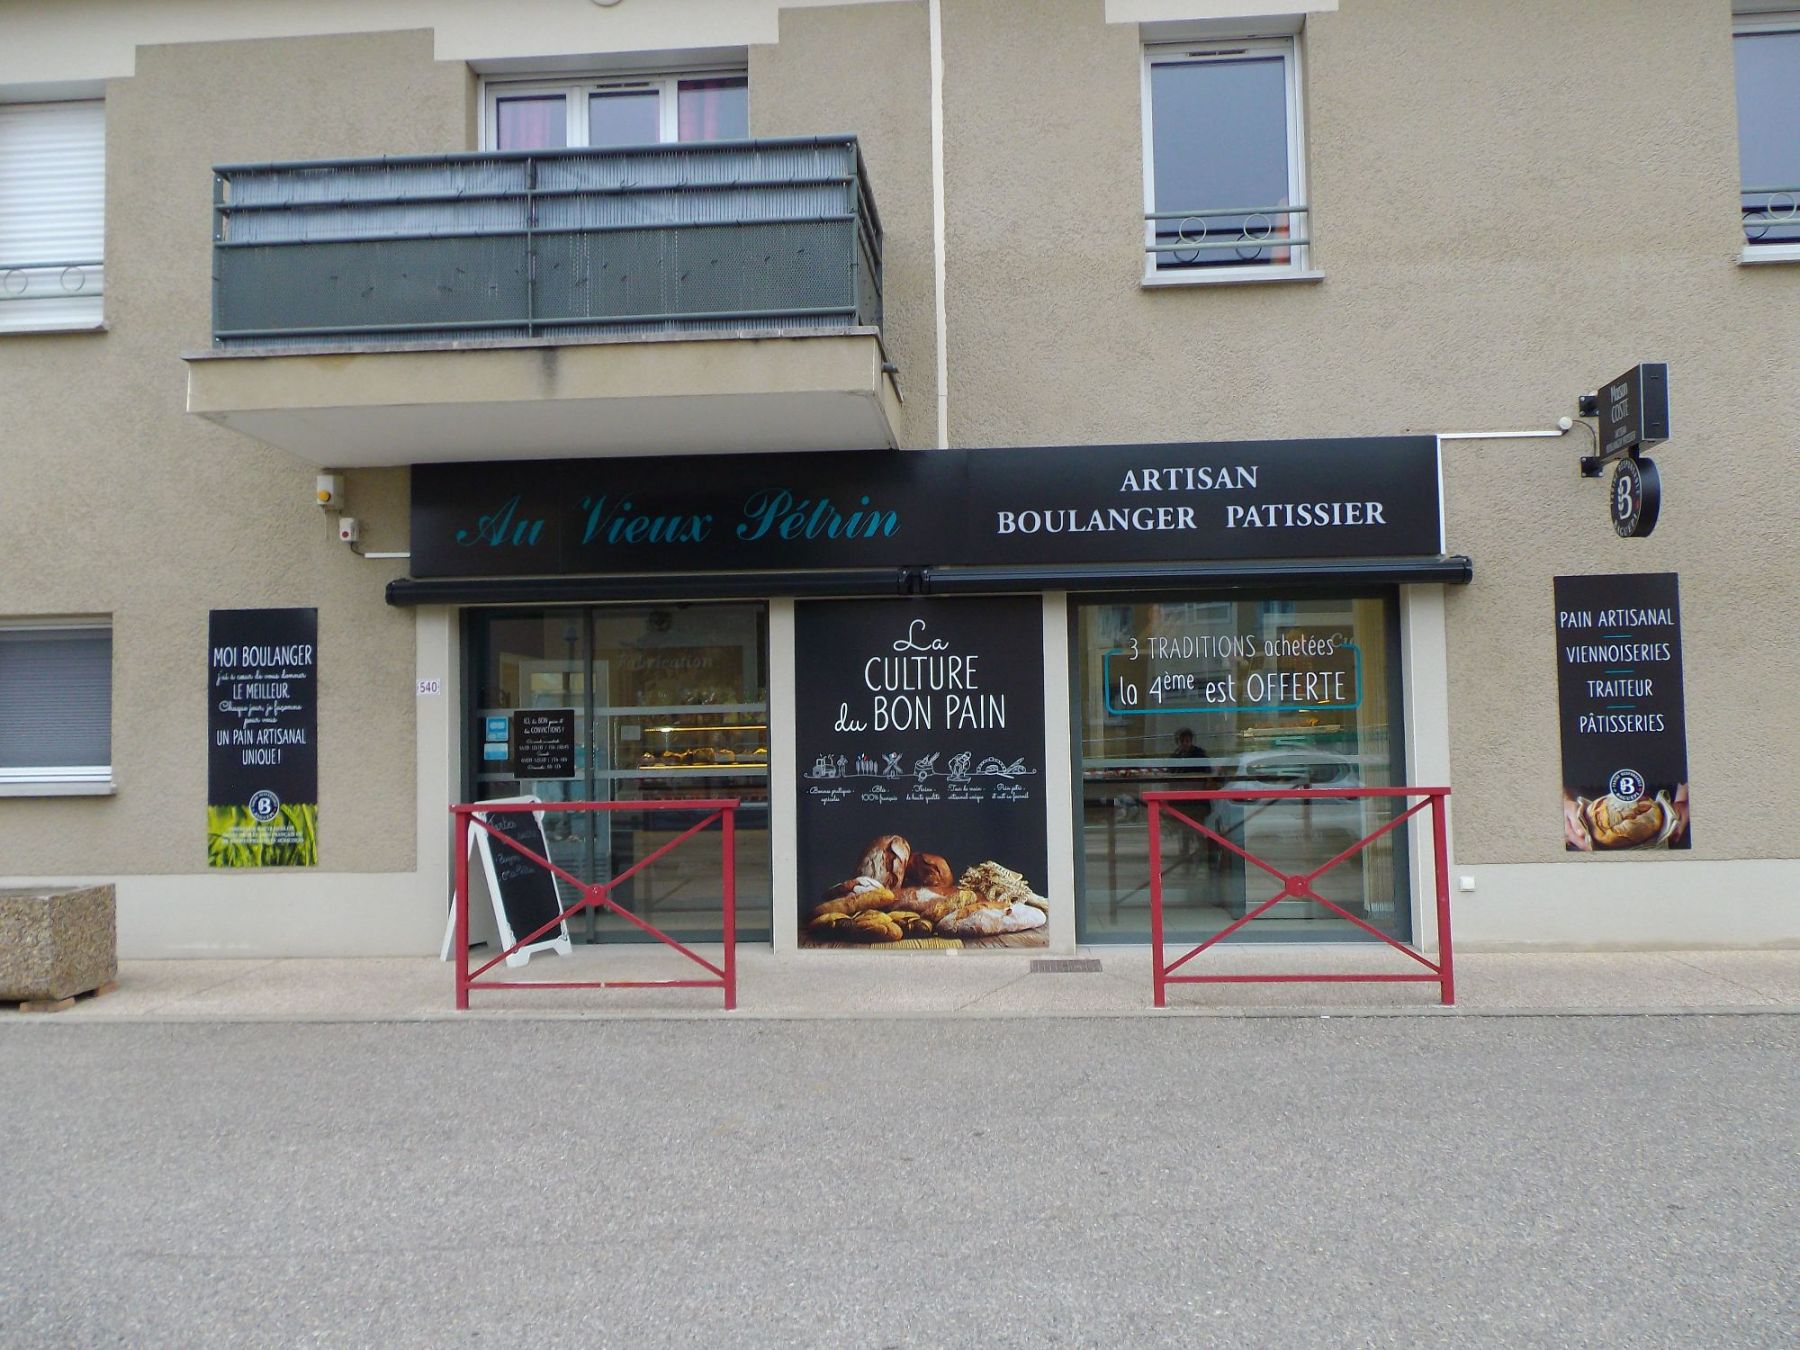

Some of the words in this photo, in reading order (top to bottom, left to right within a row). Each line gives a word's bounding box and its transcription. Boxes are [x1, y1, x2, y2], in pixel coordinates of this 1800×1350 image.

[1120, 465, 1260, 492] ARTISAN
[456, 496, 546, 548] Au
[577, 493, 713, 546] Vieux
[737, 487, 900, 541] Pétrin
[997, 505, 1198, 534] BOULANGER
[1226, 502, 1387, 529] PATISSIER
[1560, 611, 1592, 629] PAIN
[1598, 608, 1675, 628] ARTISANAL
[893, 619, 949, 651] La
[213, 647, 237, 668] MOI
[242, 644, 313, 667] BOULANGER
[1129, 637, 1139, 660] 3
[1148, 635, 1256, 660] TRADITIONS
[1264, 634, 1334, 657] achetées
[1566, 643, 1671, 664] VIENNOISERIES
[255, 669, 263, 680] de
[281, 668, 307, 680] donner
[865, 656, 978, 691] CULTURE
[233, 683, 242, 700] LE
[246, 682, 290, 699] MEILLEUR.
[420, 681, 438, 693] 540
[1120, 676, 1138, 705] la
[1149, 671, 1195, 704] 4ème
[1205, 675, 1236, 703] est
[1247, 671, 1346, 702] OFFERTE
[1587, 679, 1654, 698] TRAITEUR
[219, 700, 248, 717] Chaque
[834, 702, 867, 732] du
[874, 695, 931, 731] BON
[946, 694, 1006, 730] PAIN
[242, 717, 261, 730] pour
[1580, 713, 1664, 734] PÂTISSERIES
[216, 729, 230, 746] UN
[233, 728, 254, 746] PAIN
[256, 728, 307, 745] ARTISANAL
[1620, 777, 1635, 795] B
[861, 793, 879, 802] 100%
